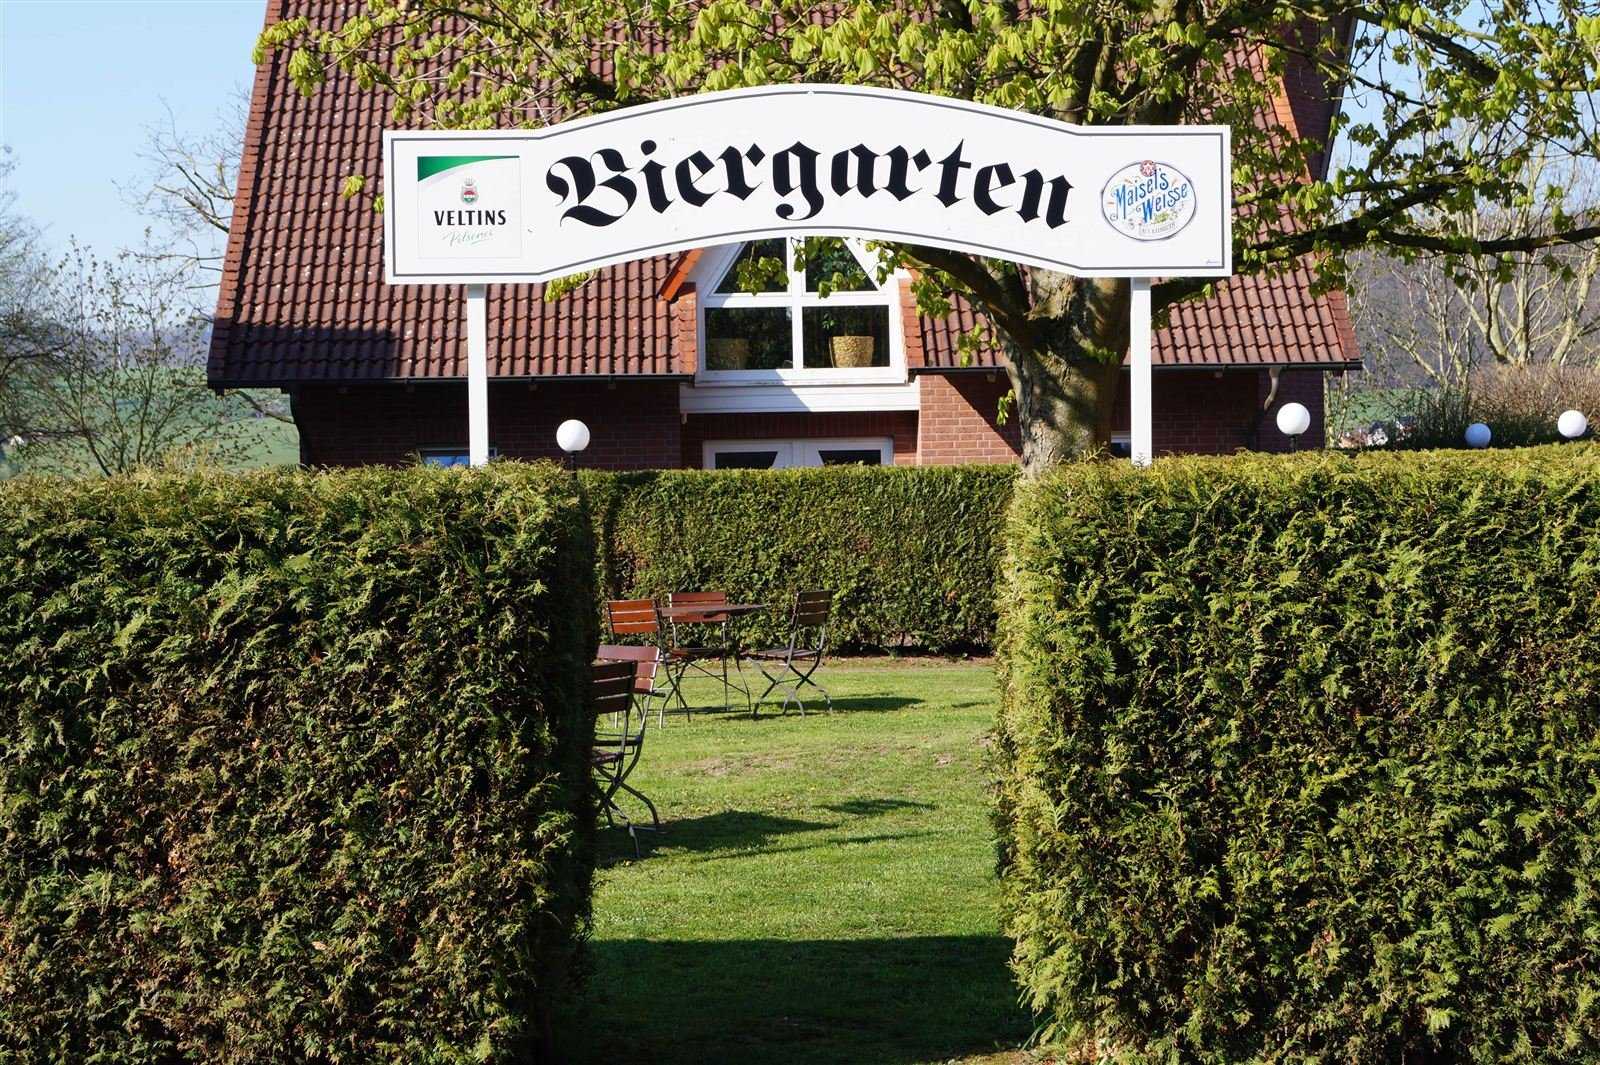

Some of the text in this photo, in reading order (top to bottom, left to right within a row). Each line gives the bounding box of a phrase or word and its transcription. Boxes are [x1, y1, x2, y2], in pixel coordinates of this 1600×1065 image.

[546, 139, 1075, 230] Biergarten
[1136, 183, 1189, 223] Weisse
[434, 209, 507, 226] VELTINS
